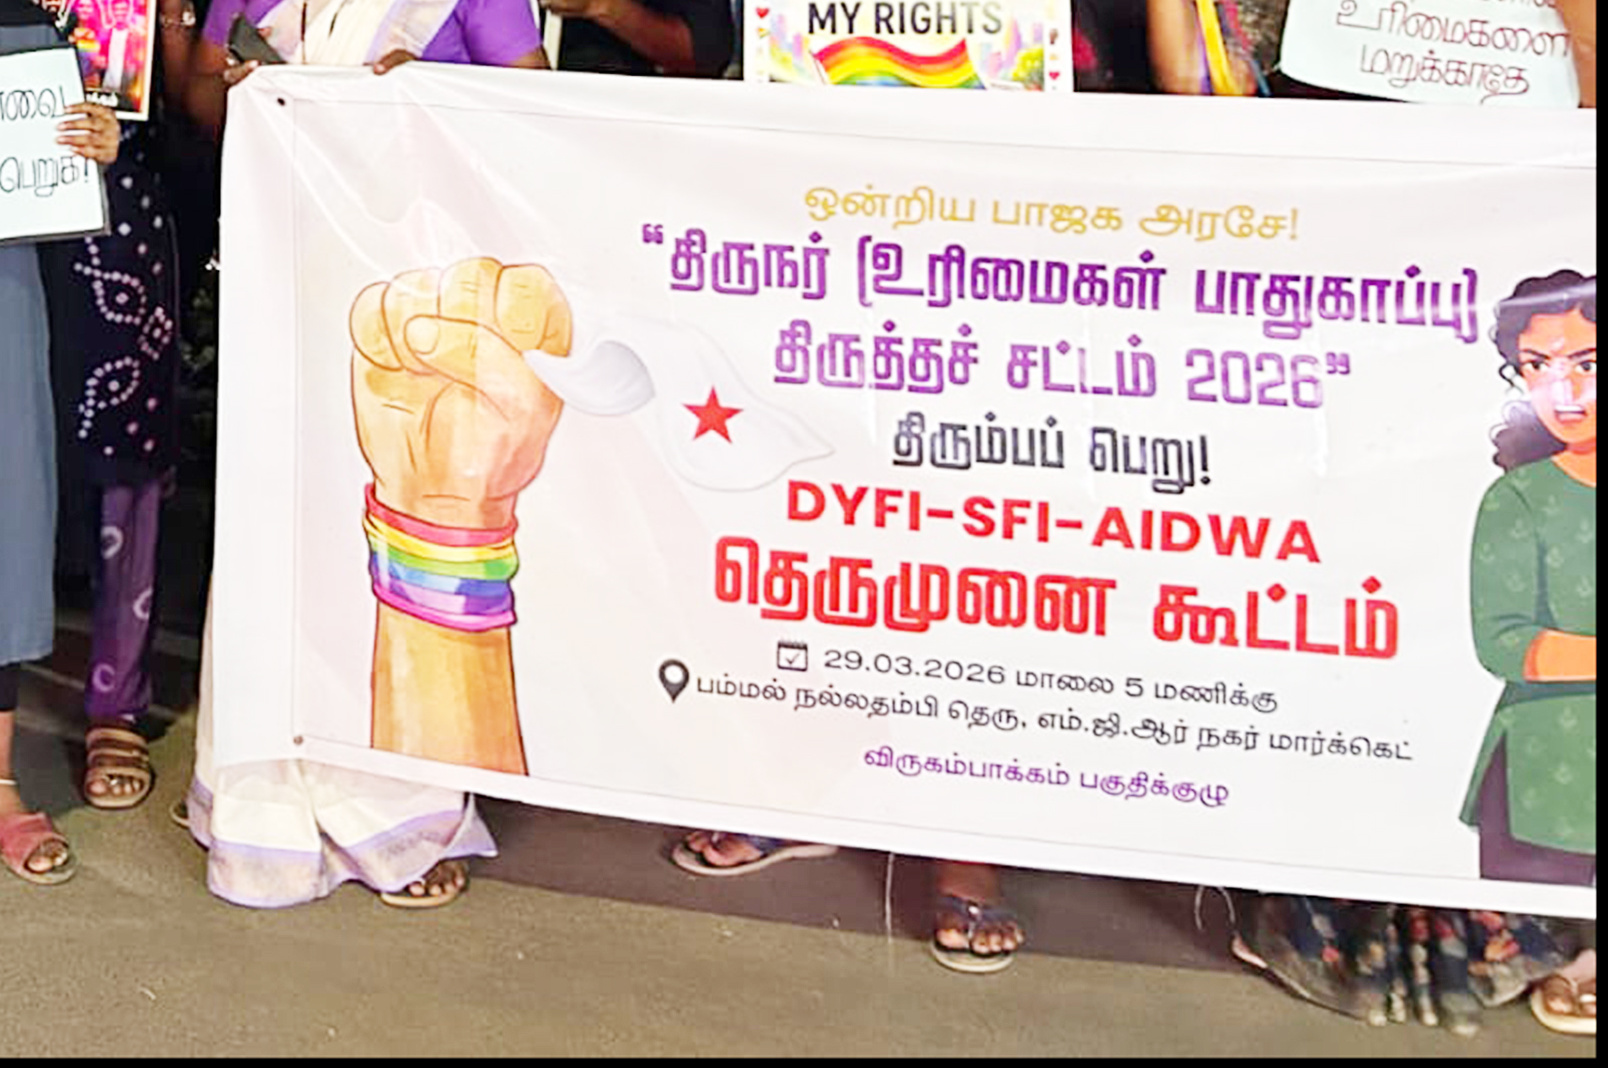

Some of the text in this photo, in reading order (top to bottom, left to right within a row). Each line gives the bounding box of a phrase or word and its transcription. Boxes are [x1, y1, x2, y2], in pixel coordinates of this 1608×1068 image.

[807, 1, 1004, 36] MY RIGHTS
[804, 183, 1300, 242] ஒன்றிய பாஜக அரசே!
[773, 319, 979, 394] திருத்தச்
[1006, 334, 1157, 398] சட்டம்
[892, 412, 1212, 495] திரும்பப் பெறு!
[715, 535, 1399, 660] தெருமுனை கூட்டம்
[696, 672, 787, 702] பம்மல்
[794, 684, 939, 719] நல்லதம்பி
[1037, 706, 1190, 746] எம்.ஜி.ஆர்
[1196, 724, 1261, 752] நகர்
[1268, 730, 1414, 762] மார்க்கெட்
[823, 649, 1279, 714] 29.03.2026 மாலை 5 மணிக்கு
[863, 744, 1230, 809] விருகம்பாக்கம் பகுதிக்குழு
